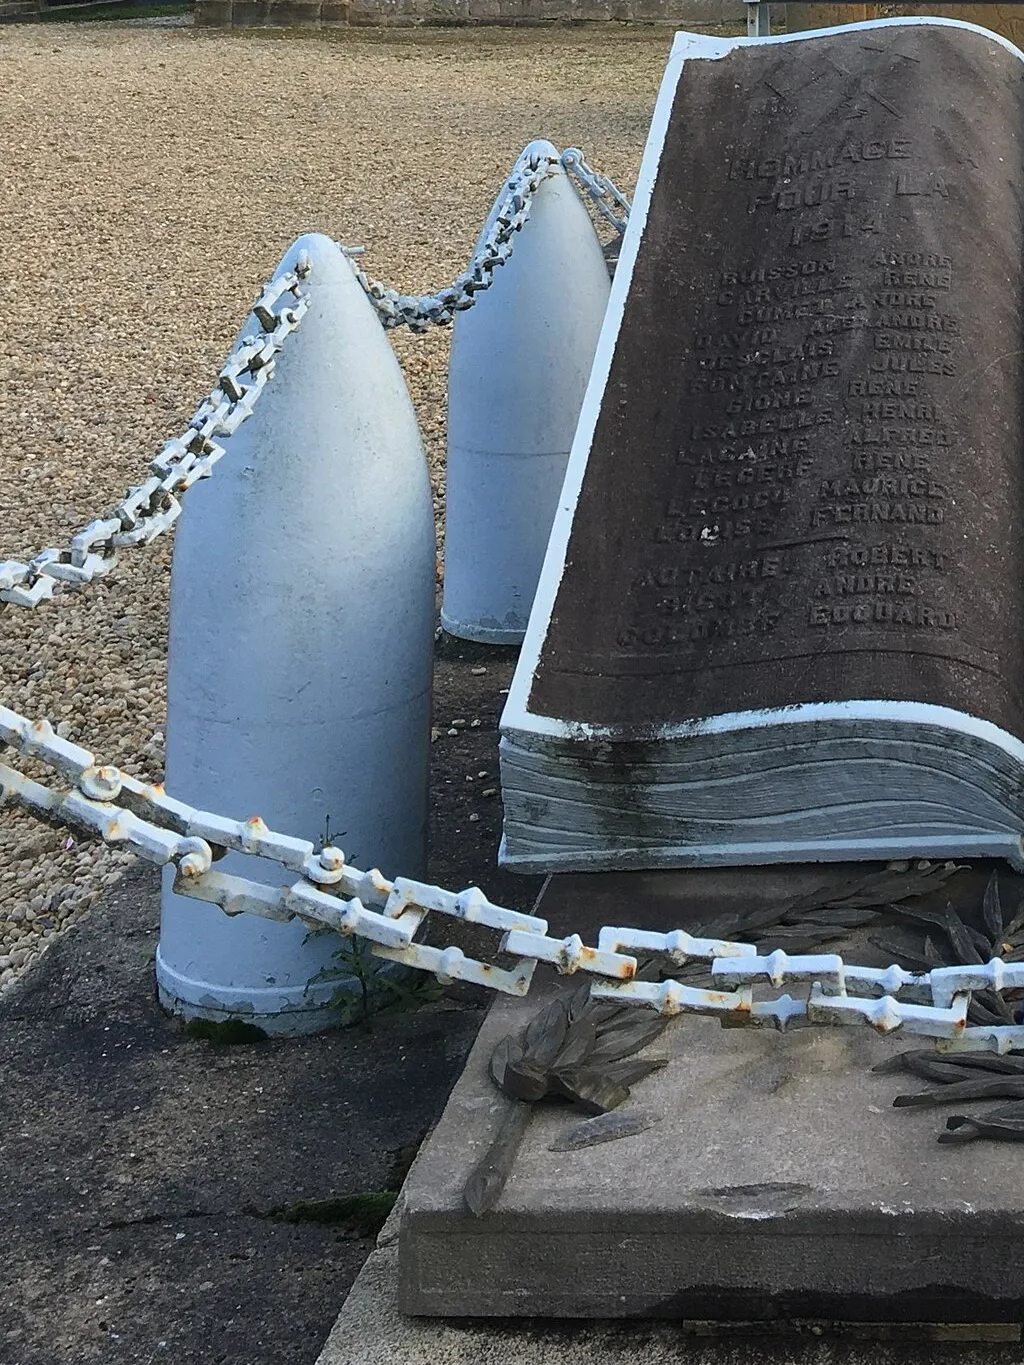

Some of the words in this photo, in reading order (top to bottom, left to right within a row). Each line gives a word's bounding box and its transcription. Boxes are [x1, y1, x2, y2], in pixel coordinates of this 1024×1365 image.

[727, 138, 912, 181] HOMMAGE
[746, 178, 857, 216] POUR
[894, 174, 950, 200] LA
[720, 258, 837, 287] BUISSON
[883, 270, 952, 291] RENE
[870, 354, 957, 379] JULES
[849, 379, 919, 399] RENE
[690, 410, 834, 441] ISABELLE
[862, 401, 939, 423] HENRI
[843, 426, 953, 449] ALFRED
[852, 452, 931, 474] RENE
[818, 477, 949, 501] MAURICE
[810, 502, 944, 528] FERNAND
[827, 545, 950, 572] ROBERT
[813, 573, 918, 598] ANDRE
[807, 601, 959, 631] EDOUARD
